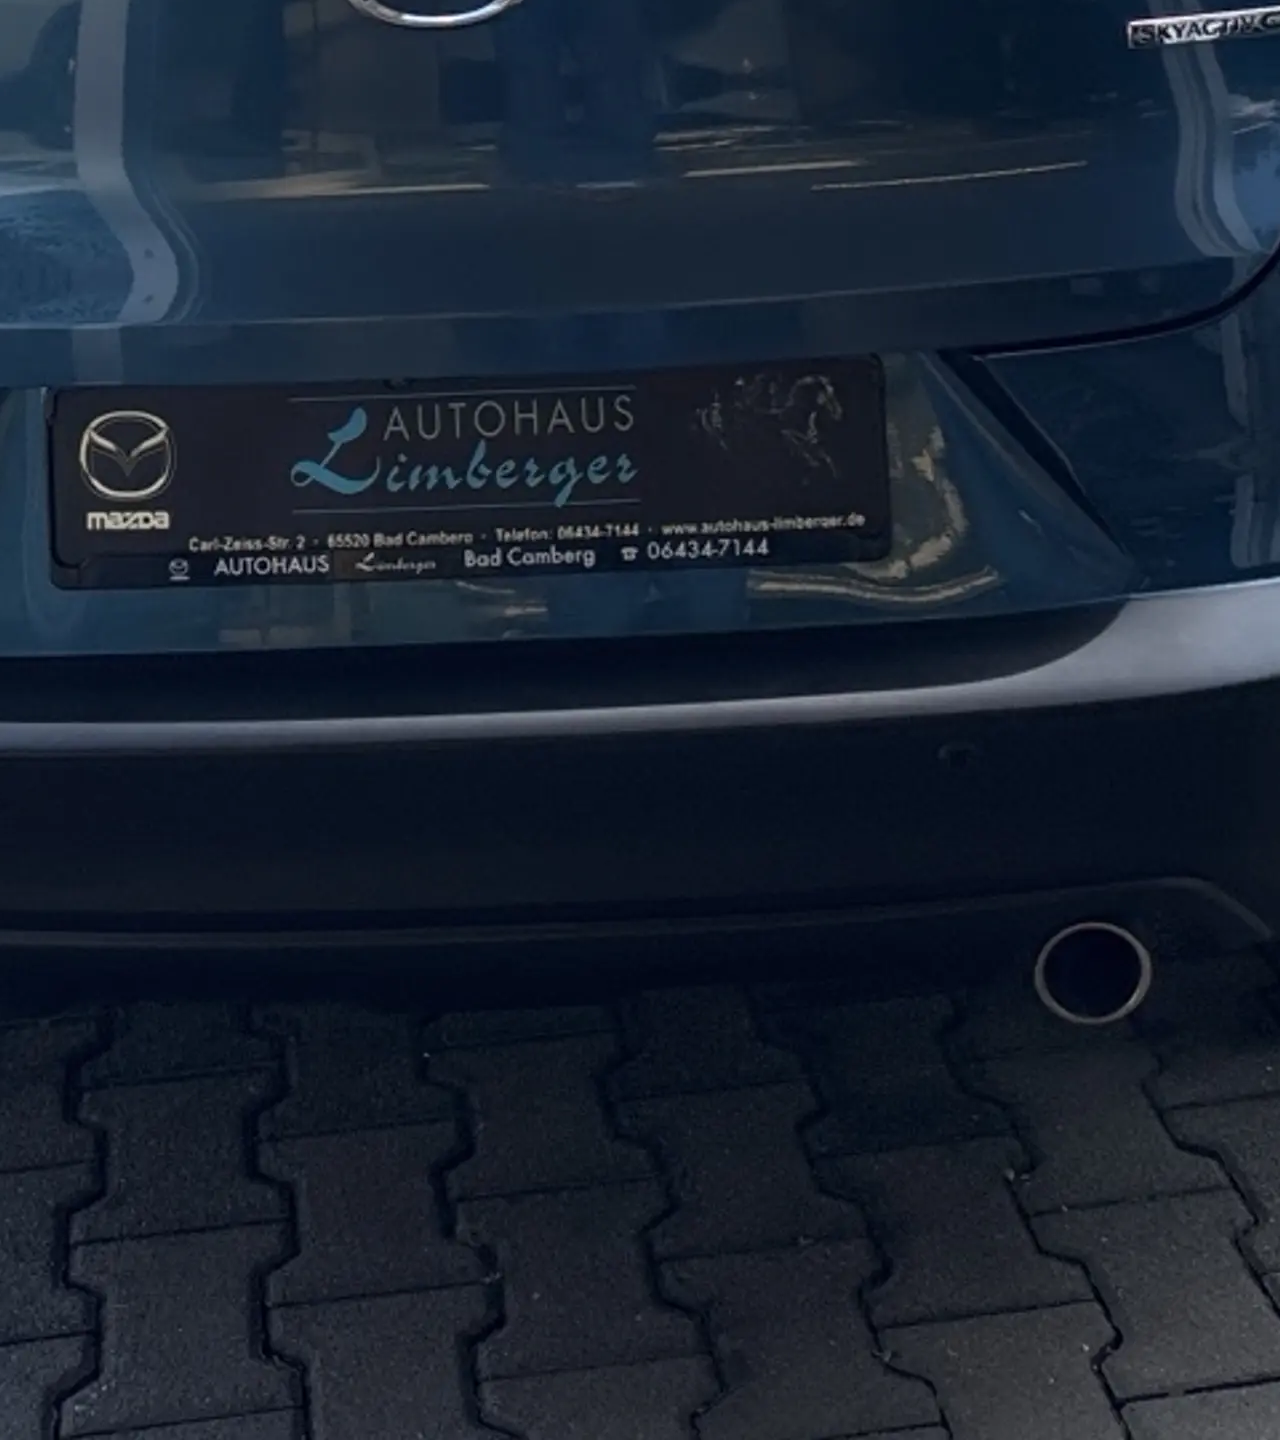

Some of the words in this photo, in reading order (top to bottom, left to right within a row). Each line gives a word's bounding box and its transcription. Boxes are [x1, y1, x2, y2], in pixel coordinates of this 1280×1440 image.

[383, 394, 635, 442] AUTOHAUS
[290, 406, 640, 508] Limberger
[188, 533, 292, 553] Carl-Zeiss-Str.
[296, 536, 307, 550] 2
[327, 533, 370, 549] 65520
[373, 532, 404, 547] Bad
[495, 526, 553, 542] Telefon:
[556, 522, 640, 541] 06434-7144
[213, 554, 330, 576] AUTOHAUS
[463, 547, 502, 568] Bad
[506, 545, 597, 568] Camberg
[646, 537, 770, 560] 06434-7144
